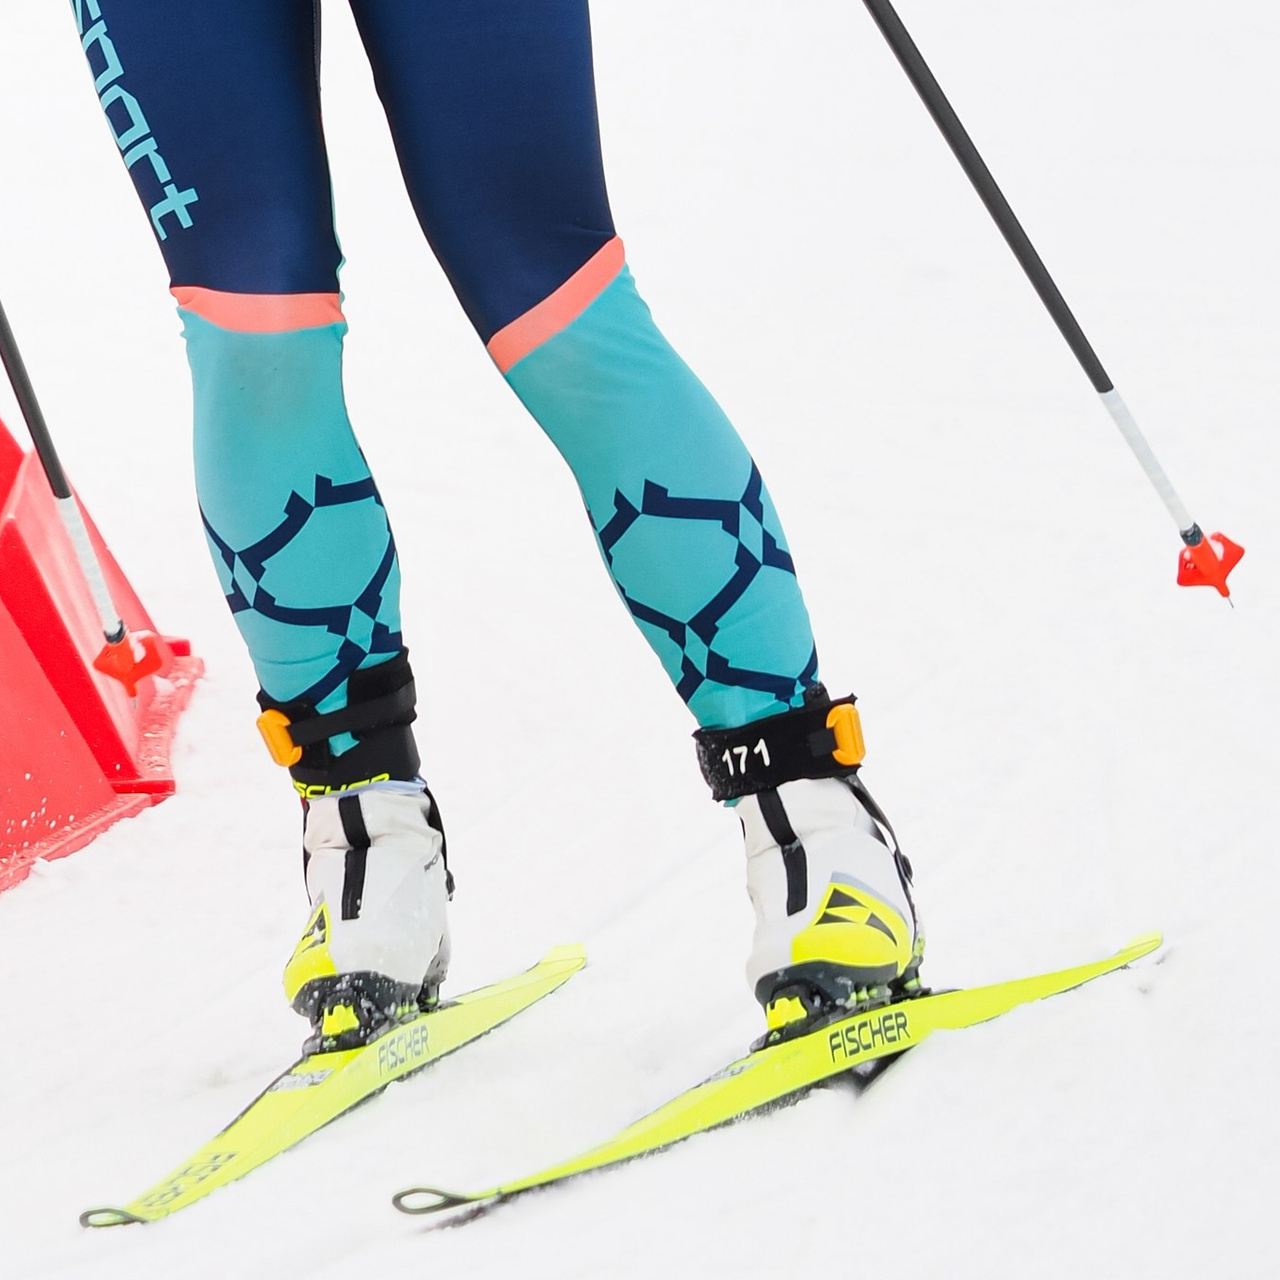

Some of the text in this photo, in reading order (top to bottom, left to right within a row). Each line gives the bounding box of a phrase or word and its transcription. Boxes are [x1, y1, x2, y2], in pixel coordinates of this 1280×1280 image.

[721, 738, 771, 777] 171
[378, 1024, 430, 1077] FISCHER
[828, 1011, 911, 1063] FISCHER
